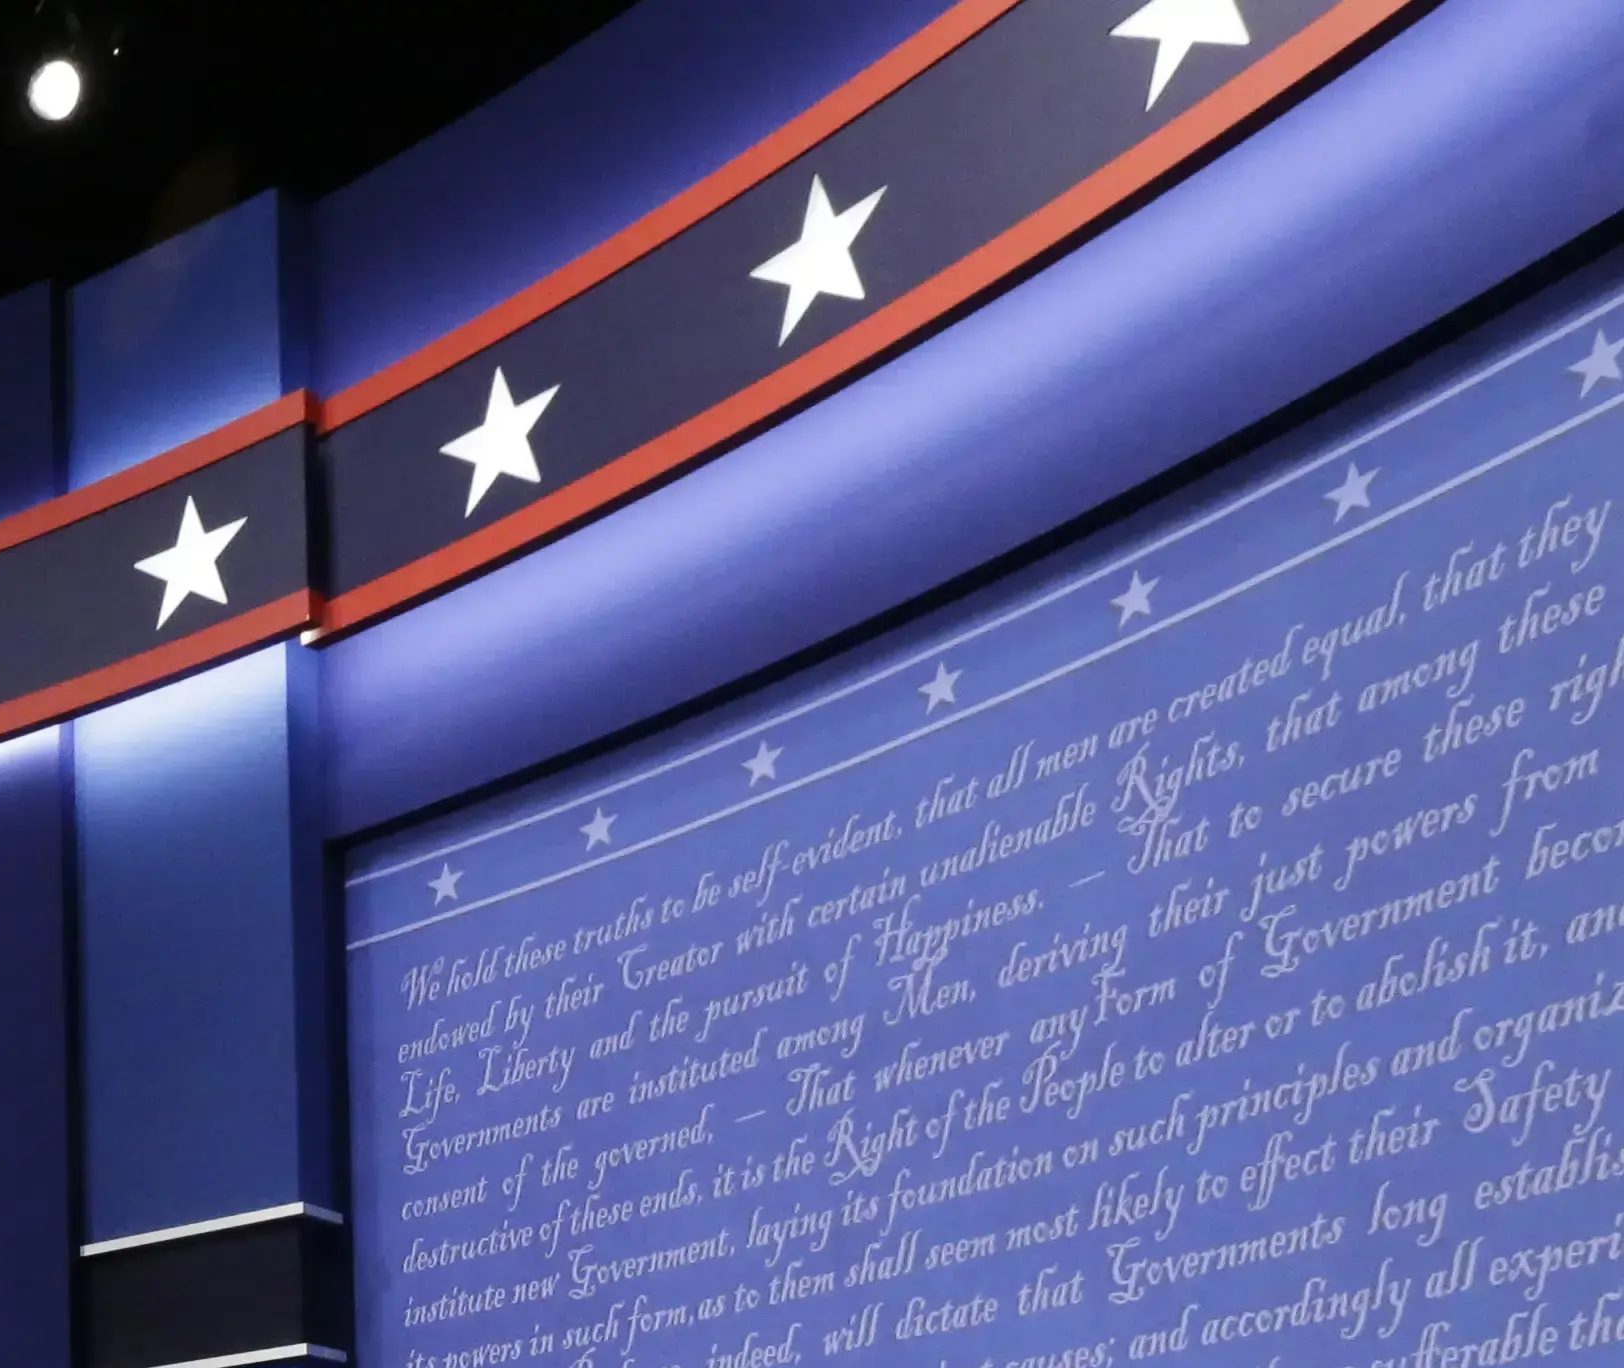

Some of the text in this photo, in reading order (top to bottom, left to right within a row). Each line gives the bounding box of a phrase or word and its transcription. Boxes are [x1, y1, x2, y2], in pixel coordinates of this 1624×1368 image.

[398, 581, 1605, 1064] endowed by their Creator with certain unalienable Rights, that among these
[399, 693, 1526, 1122] Life, Liberty and the pursuit of Happiness. That to secure these
[400, 494, 1612, 1011] We hold these truths to be self-evident, that all men are created equal, that they
[402, 747, 1599, 1176] Governments are instituted among Men, deriving their just powers from
[401, 854, 1500, 1221] consent of the governed, That whenever any Form of Government
[823, 1302, 883, 1357] will
[895, 1293, 998, 1340] dictate
[1018, 1263, 1084, 1317] that
[1106, 1212, 1345, 1305] Governments
[1367, 1180, 1448, 1248] long
